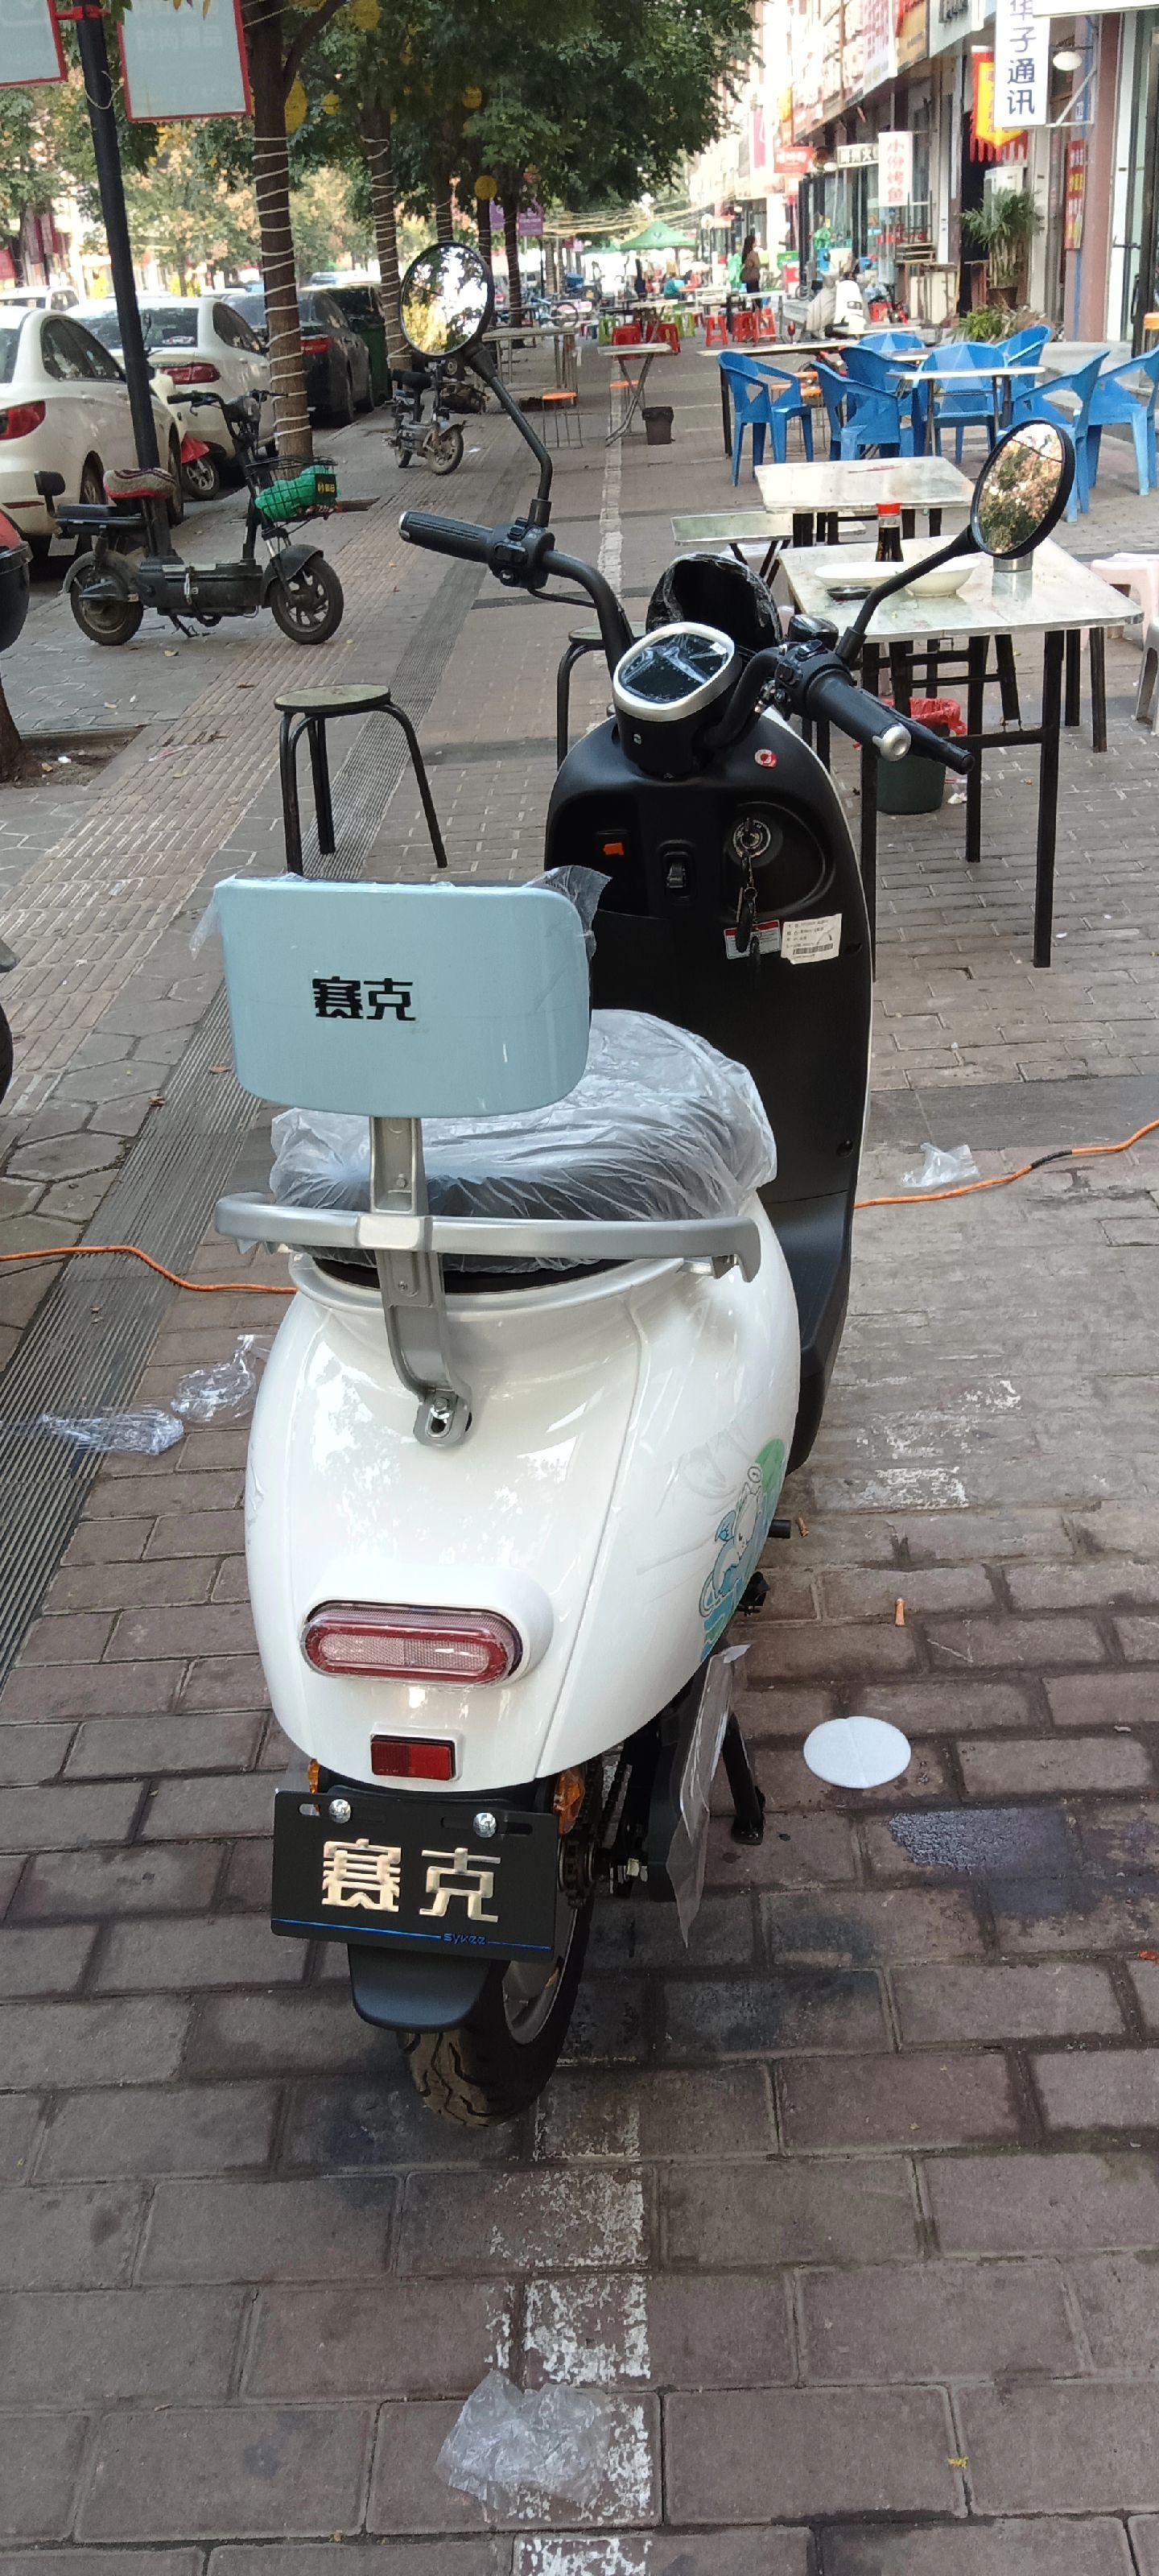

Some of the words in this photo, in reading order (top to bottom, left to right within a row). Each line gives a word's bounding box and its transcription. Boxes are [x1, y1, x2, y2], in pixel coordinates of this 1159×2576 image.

[1007, 0, 1037, 114] 华子通讯
[312, 976, 416, 1021] 赛克
[322, 1839, 501, 1922] 赛克
